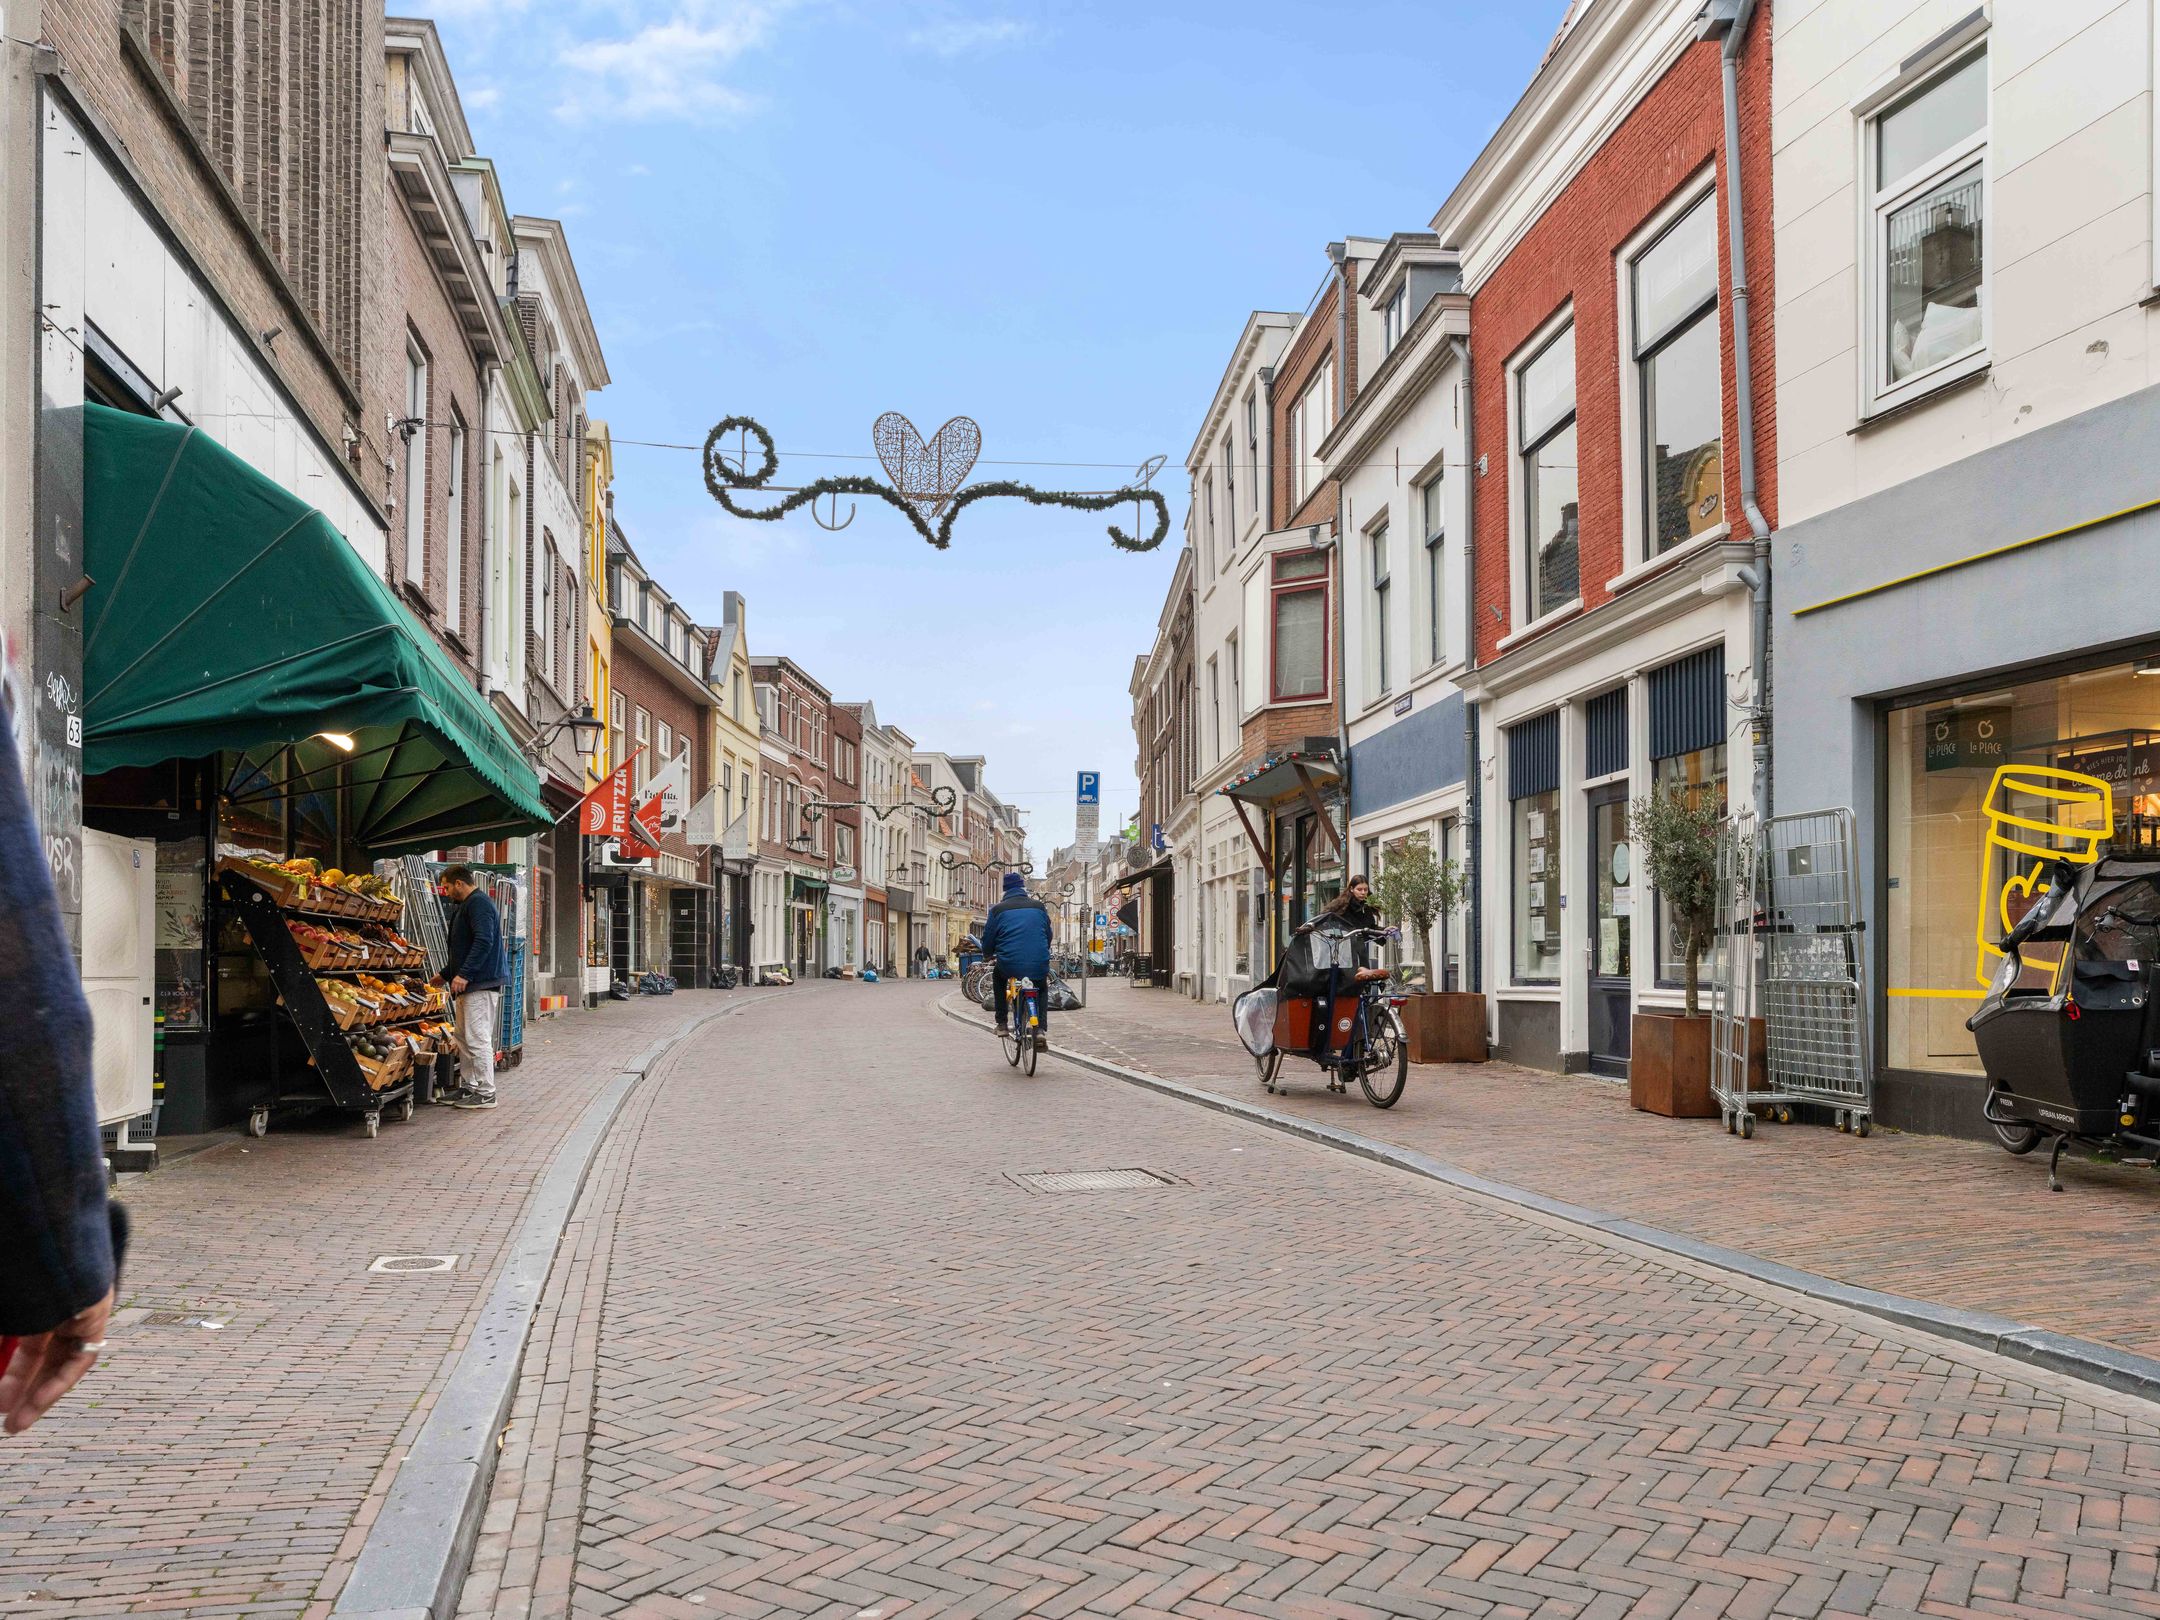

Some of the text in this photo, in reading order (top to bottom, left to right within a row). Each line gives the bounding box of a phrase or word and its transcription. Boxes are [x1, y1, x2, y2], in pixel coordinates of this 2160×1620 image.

[68, 719, 80, 744] 63
[1936, 742, 1956, 757] PLACE
[1979, 741, 2002, 755] PLACE
[2114, 758, 2151, 780] drnk
[1083, 775, 1094, 791] P
[2038, 1108, 2075, 1124] URBAN ARROW
